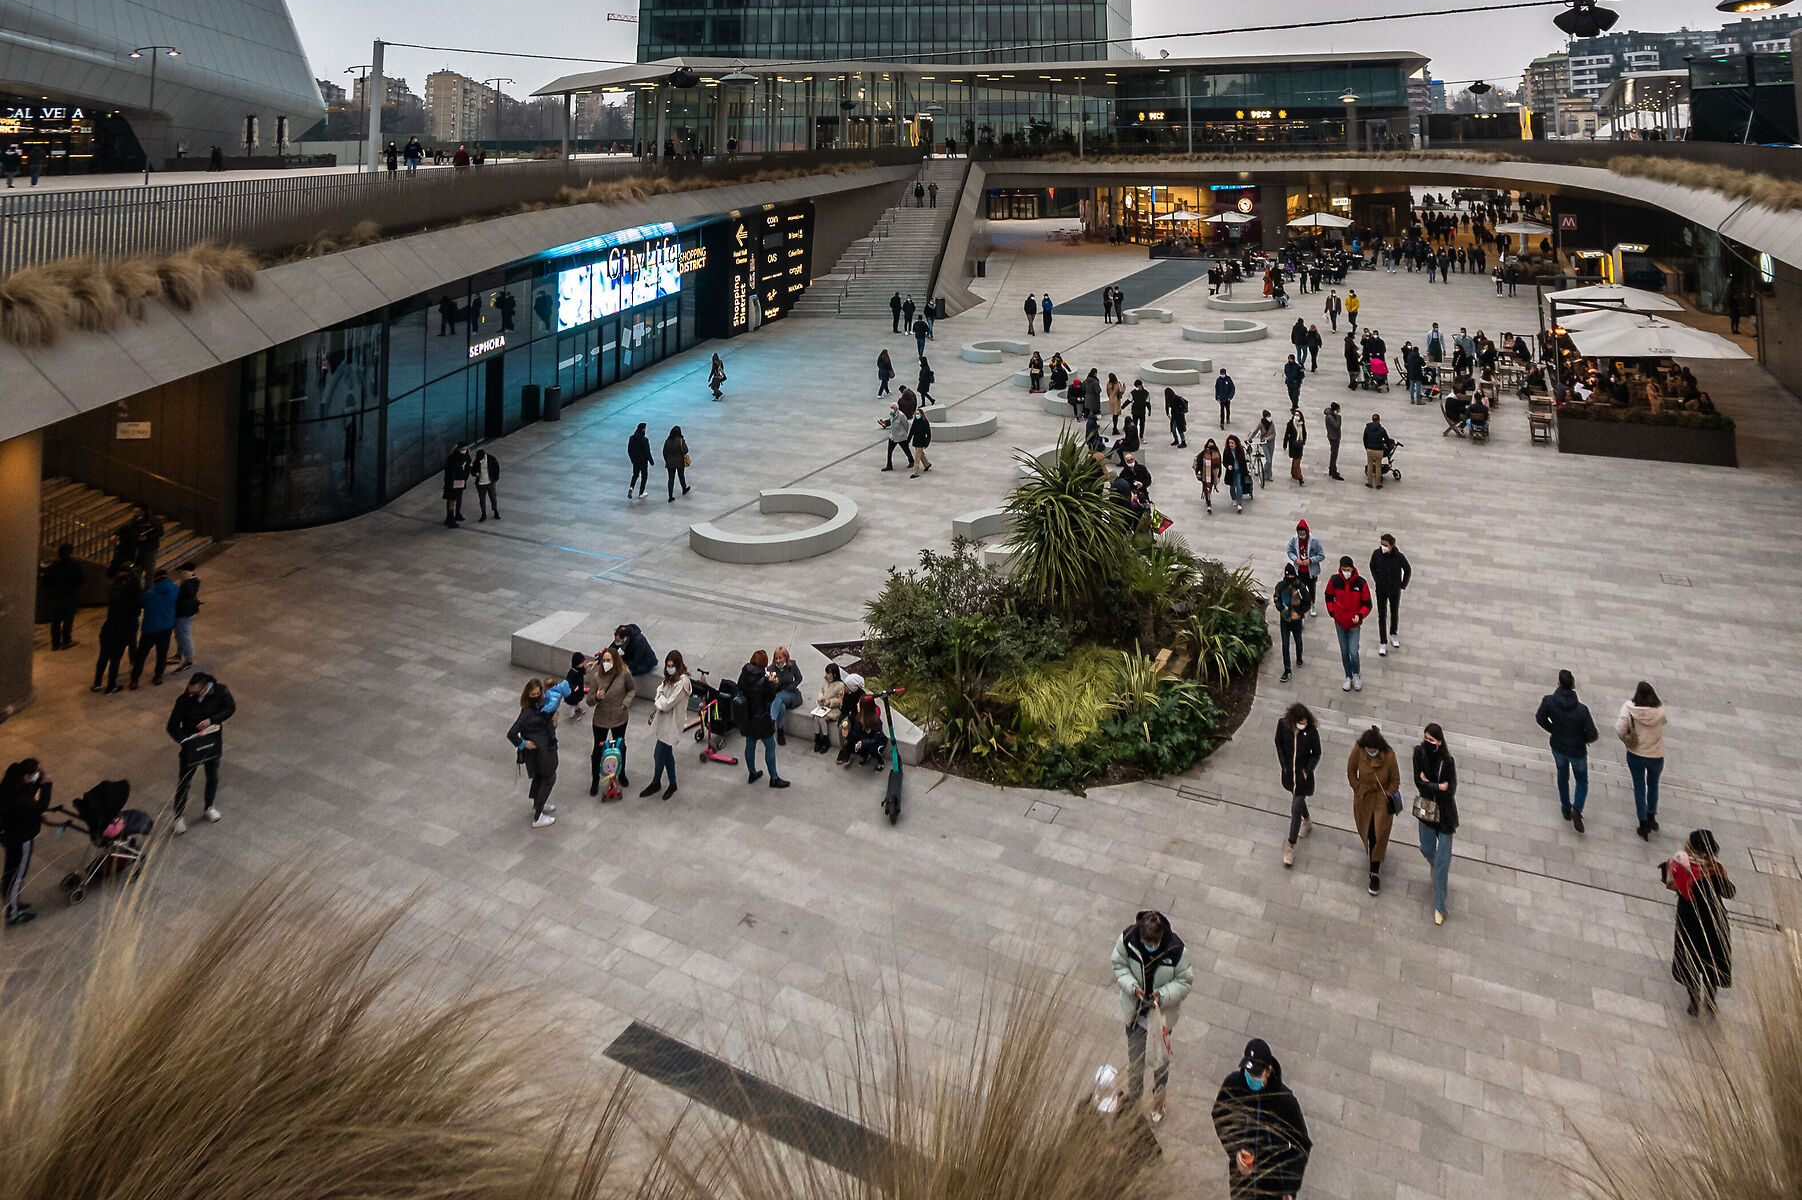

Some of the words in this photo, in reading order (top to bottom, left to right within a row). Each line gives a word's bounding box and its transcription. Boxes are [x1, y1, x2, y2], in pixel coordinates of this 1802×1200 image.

[679, 246, 706, 263] SHOPPING
[679, 257, 706, 274] DISTRICT
[469, 335, 506, 358] SEPHORA
